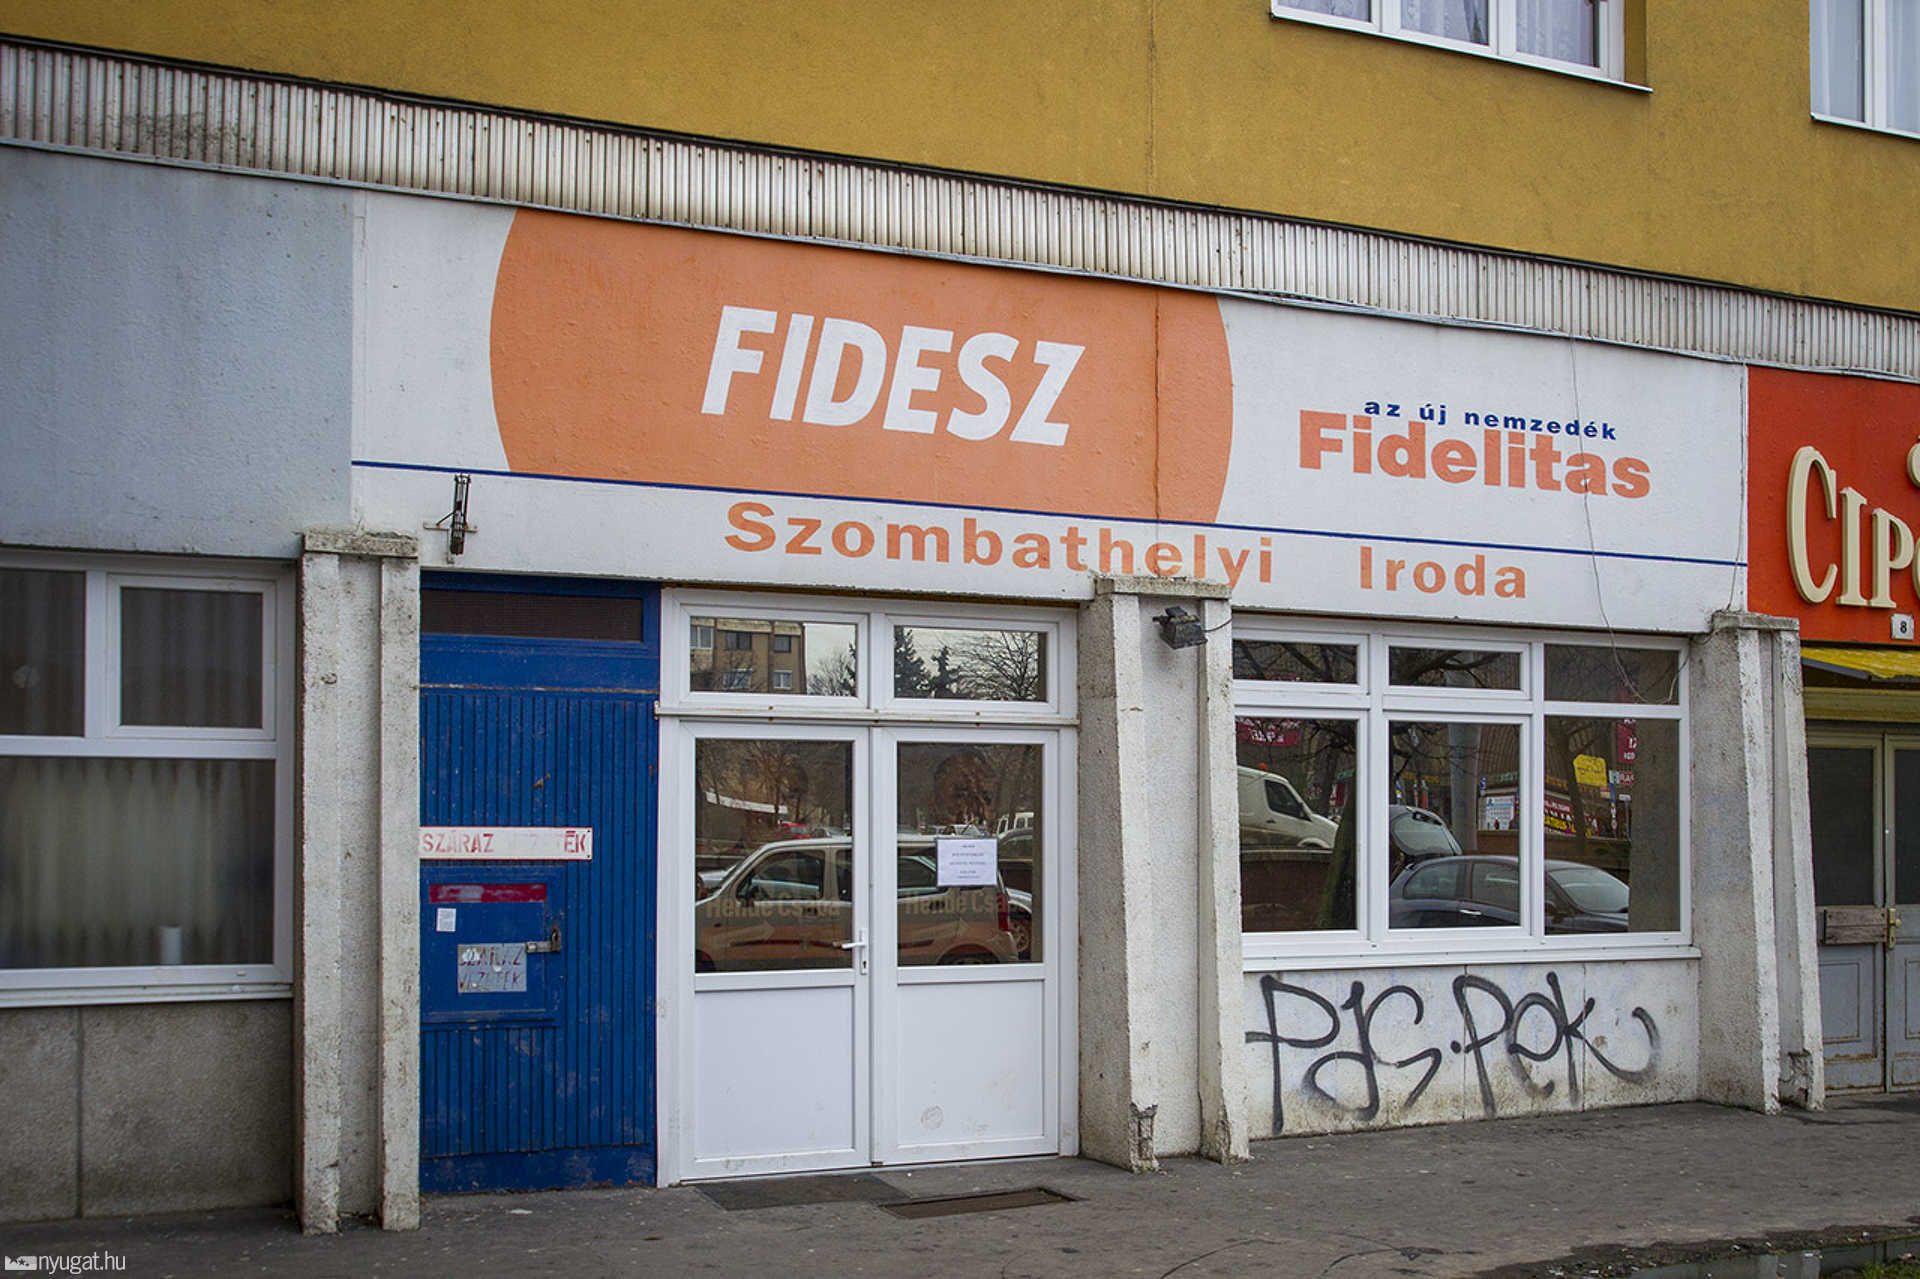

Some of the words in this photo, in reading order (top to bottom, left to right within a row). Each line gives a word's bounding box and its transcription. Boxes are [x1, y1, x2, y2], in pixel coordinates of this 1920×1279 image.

[702, 306, 1086, 446] FIDESZ
[1364, 401, 1401, 417] az
[1419, 404, 1447, 426] új
[1464, 408, 1617, 441] nemzedék
[1299, 409, 1651, 499] Fidelitas
[723, 502, 1272, 590] Szombathelyi
[1360, 546, 1526, 599] Iroda
[1786, 445, 1920, 609] CIP
[1899, 620, 1908, 634] 8
